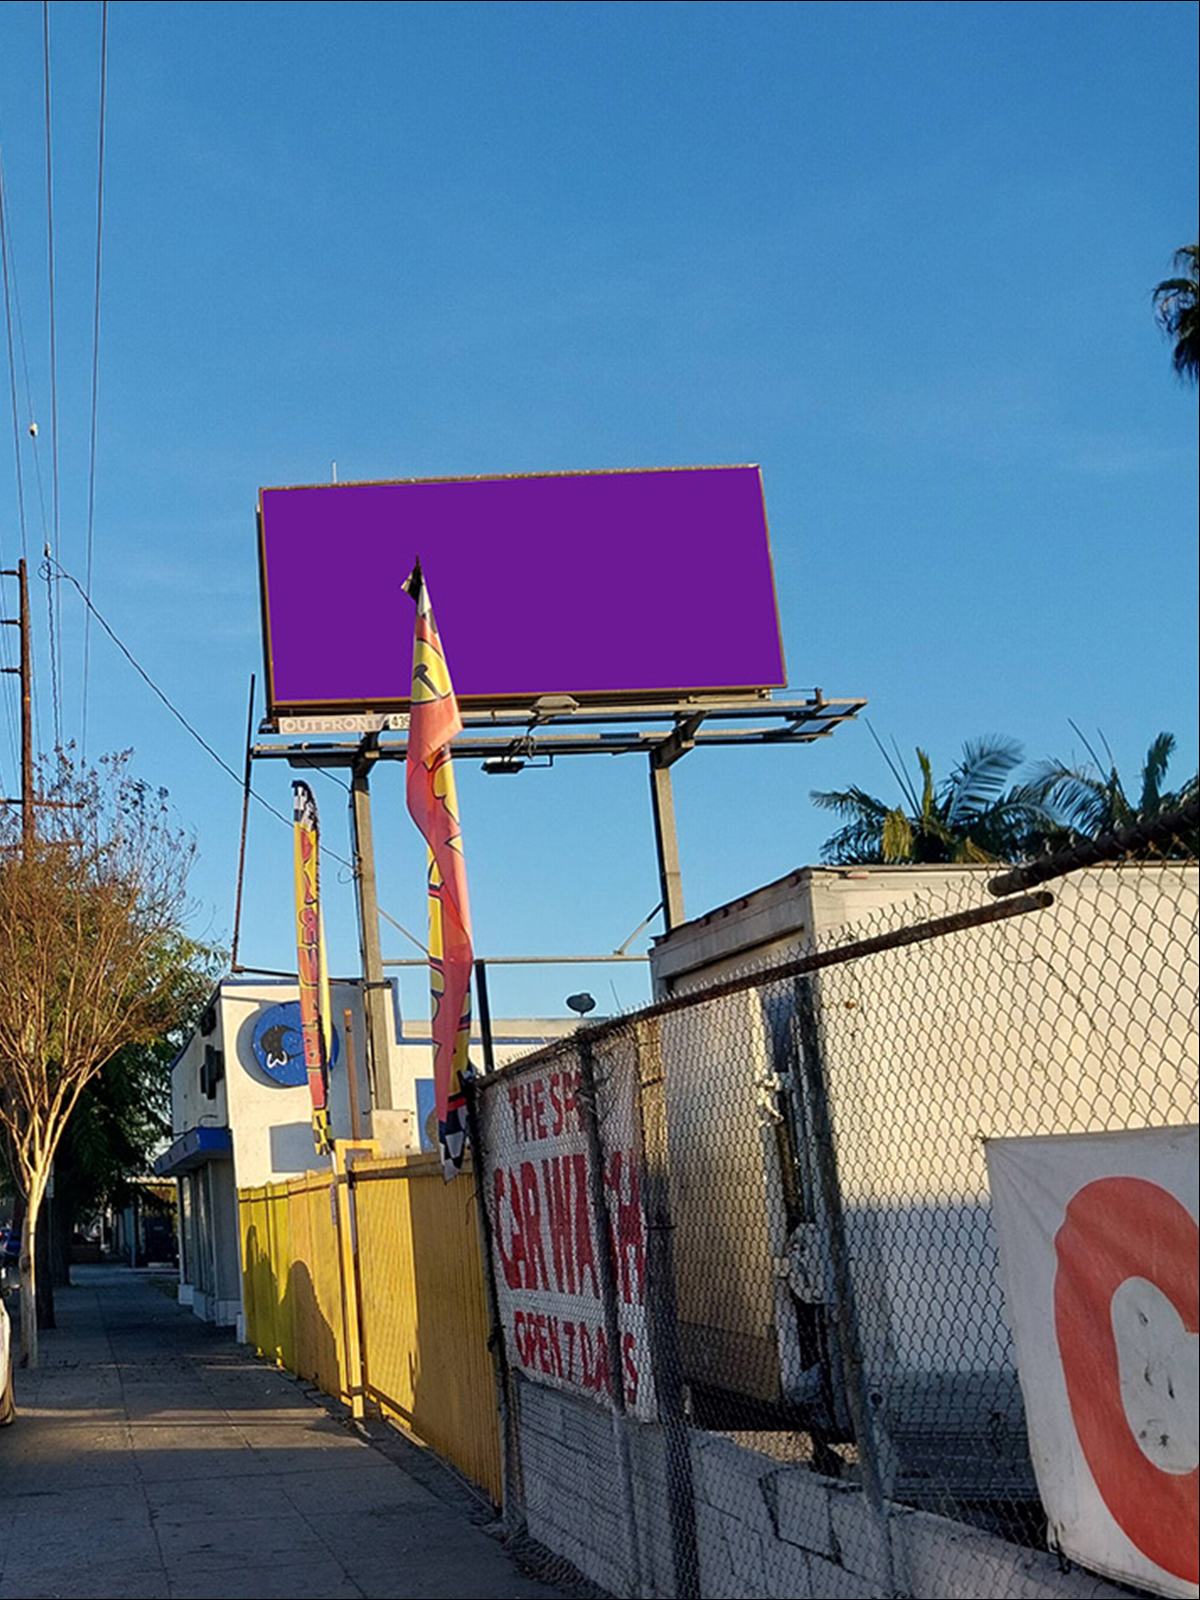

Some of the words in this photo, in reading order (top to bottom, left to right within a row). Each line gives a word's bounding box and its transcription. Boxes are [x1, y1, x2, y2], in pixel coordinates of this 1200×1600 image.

[283, 717, 379, 732] OUTFRONT
[508, 1078, 549, 1143] THE
[494, 1160, 550, 1290] CAR
[514, 1310, 563, 1378] OPEN
[580, 1321, 638, 1405] DAS
